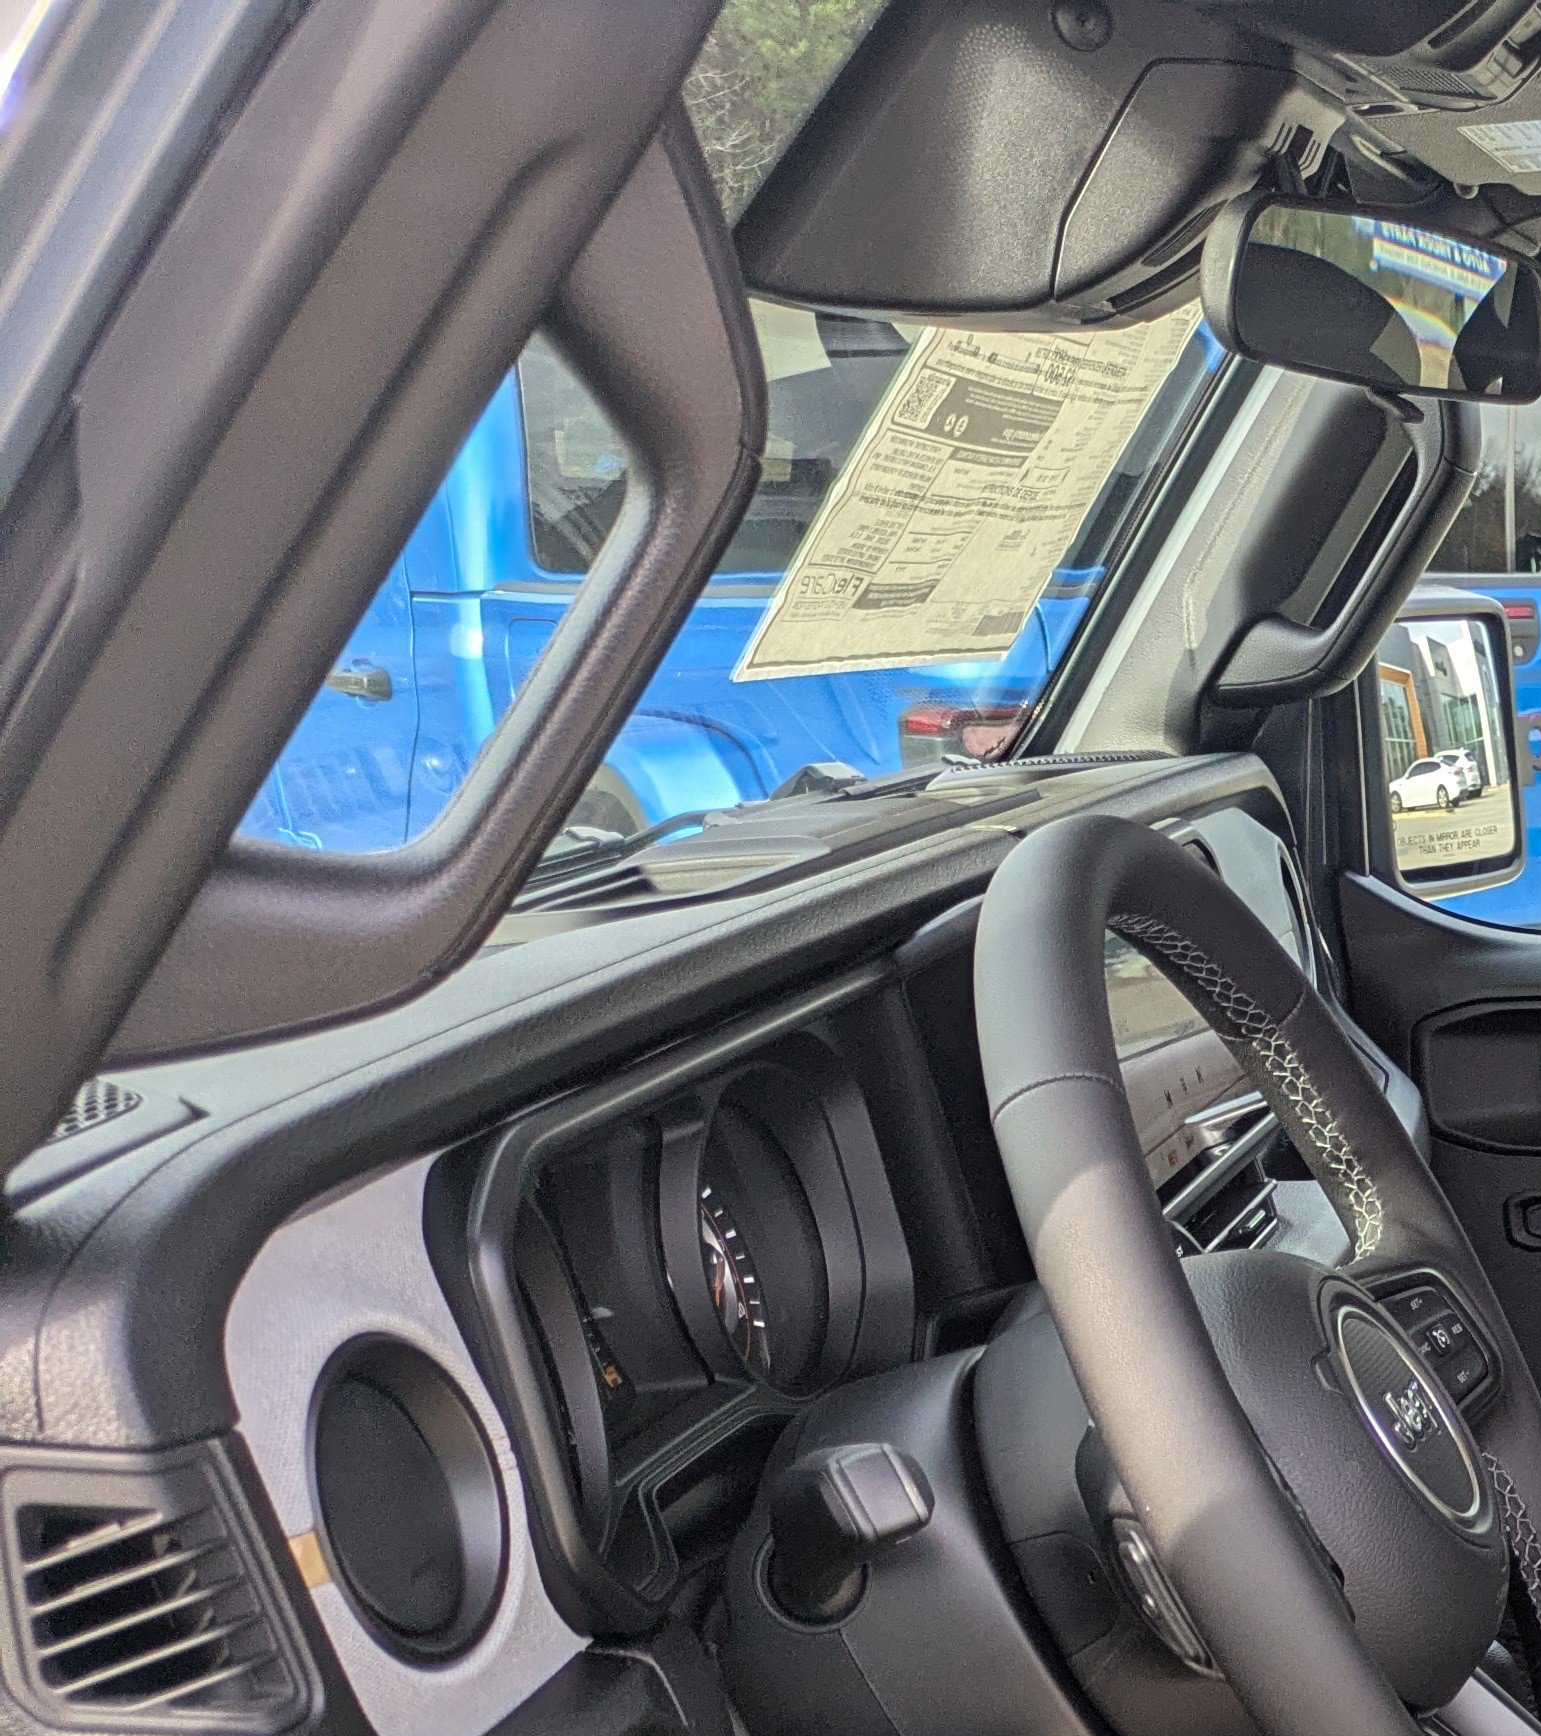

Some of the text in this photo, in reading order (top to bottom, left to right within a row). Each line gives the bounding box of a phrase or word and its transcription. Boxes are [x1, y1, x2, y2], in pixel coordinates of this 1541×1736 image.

[1396, 835, 1427, 847] OBJECTS
[1436, 830, 1458, 842] MIRROR
[1460, 828, 1472, 838] ARE
[1474, 825, 1498, 837] CLOSER
[1419, 839, 1481, 855] THAN THEY APPEAR
